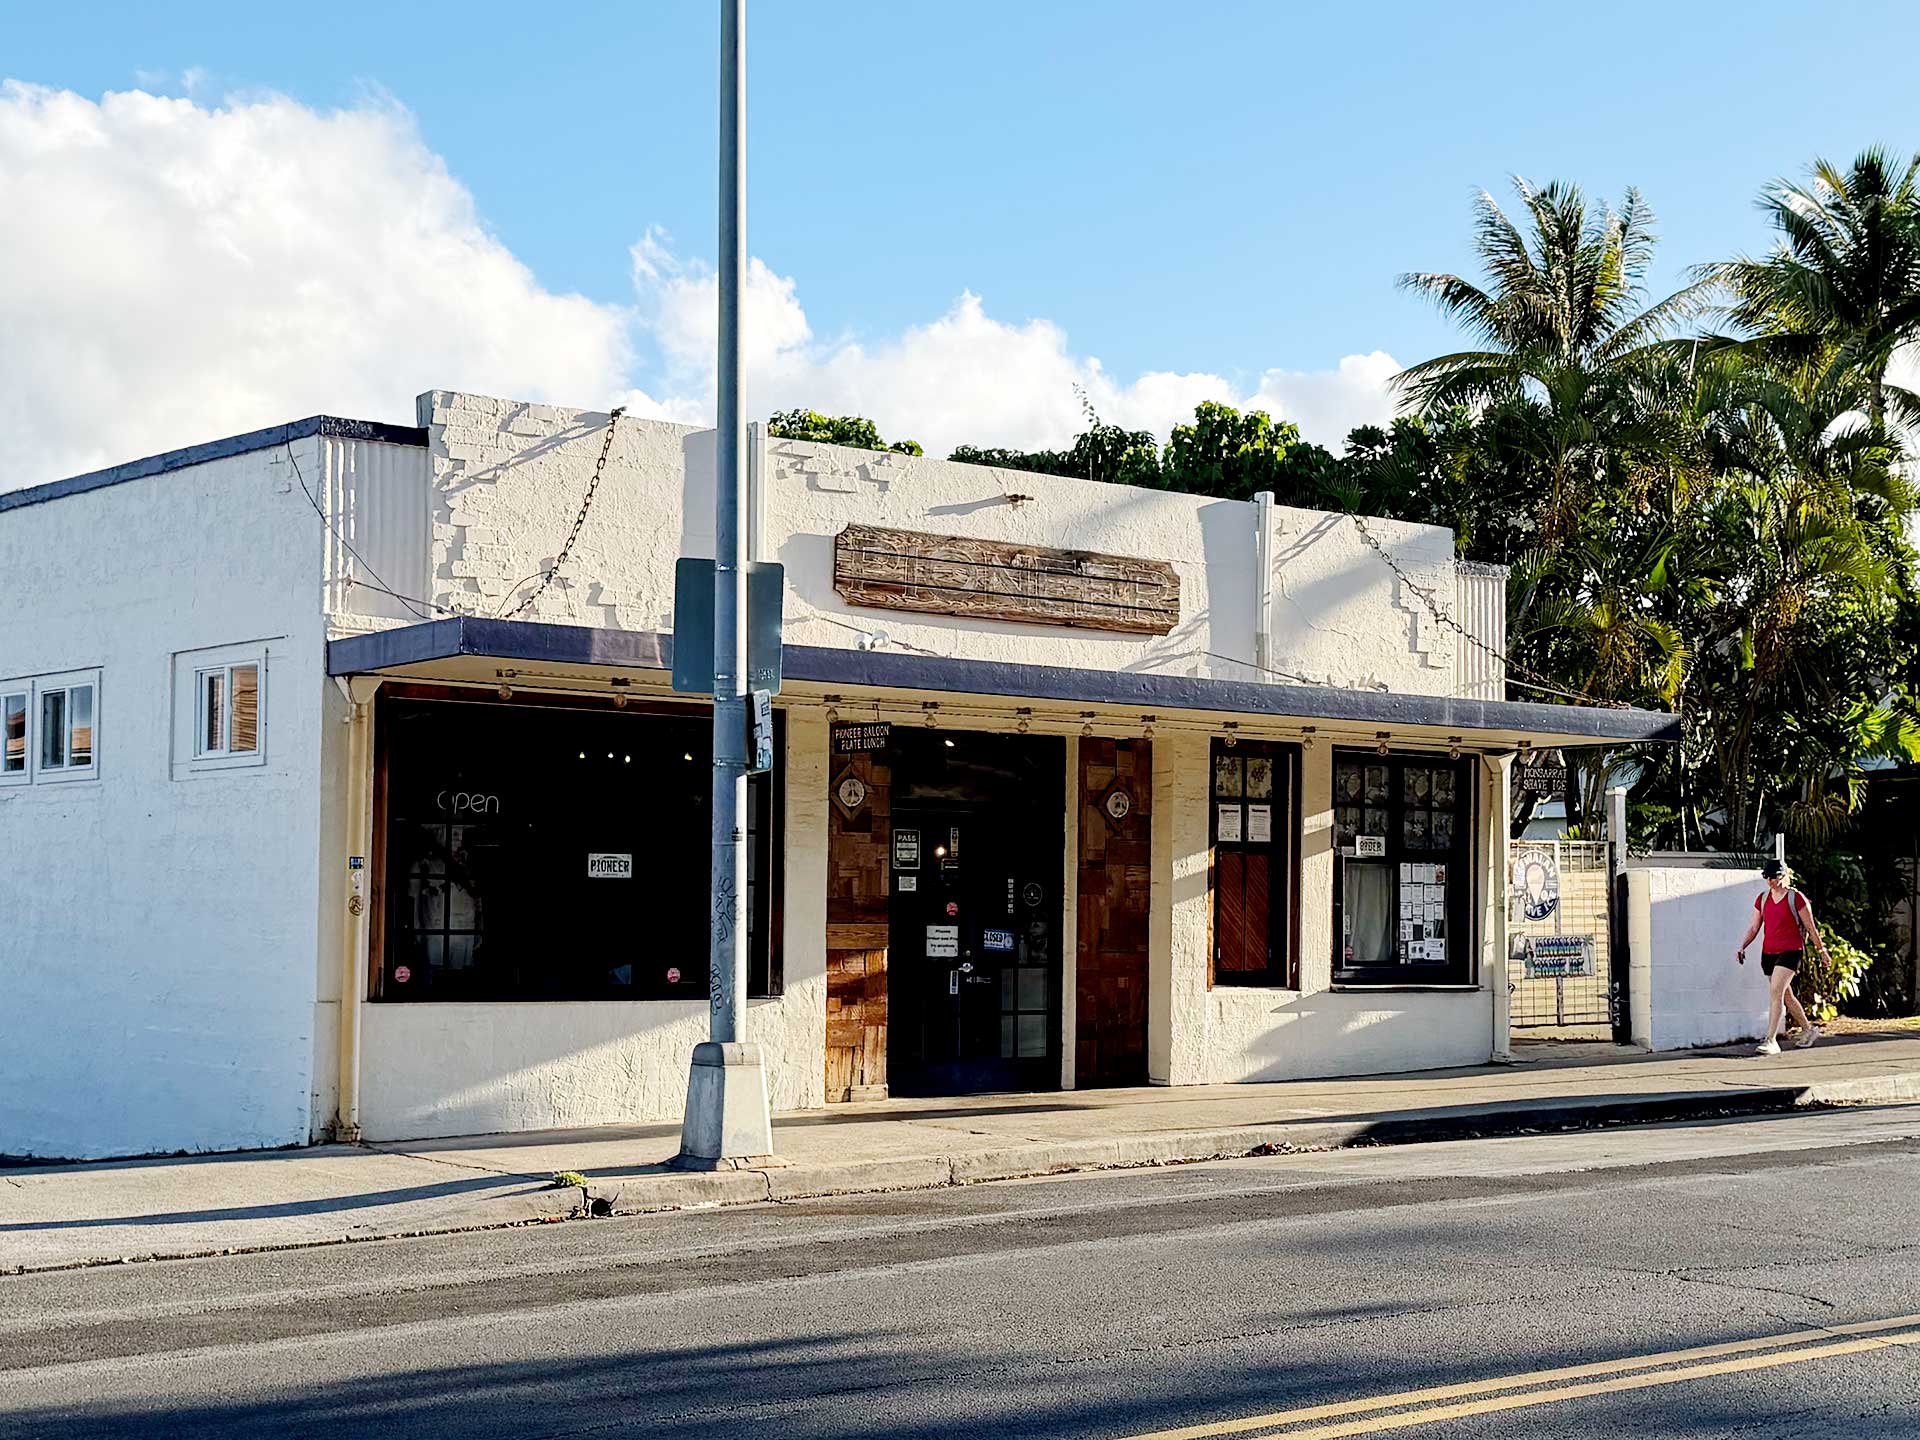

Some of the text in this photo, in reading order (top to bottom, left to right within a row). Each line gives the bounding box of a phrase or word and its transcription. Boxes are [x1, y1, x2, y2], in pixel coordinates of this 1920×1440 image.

[848, 535, 1171, 624] PIONEER
[835, 725, 890, 740] PIONEER SALOON
[841, 737, 886, 751] PLATE LUNCH
[1523, 767, 1568, 779] MONSARRAT
[1523, 778, 1568, 791] SHAVE ICE
[897, 834, 917, 842] PASS
[590, 859, 630, 873] PIONEER
